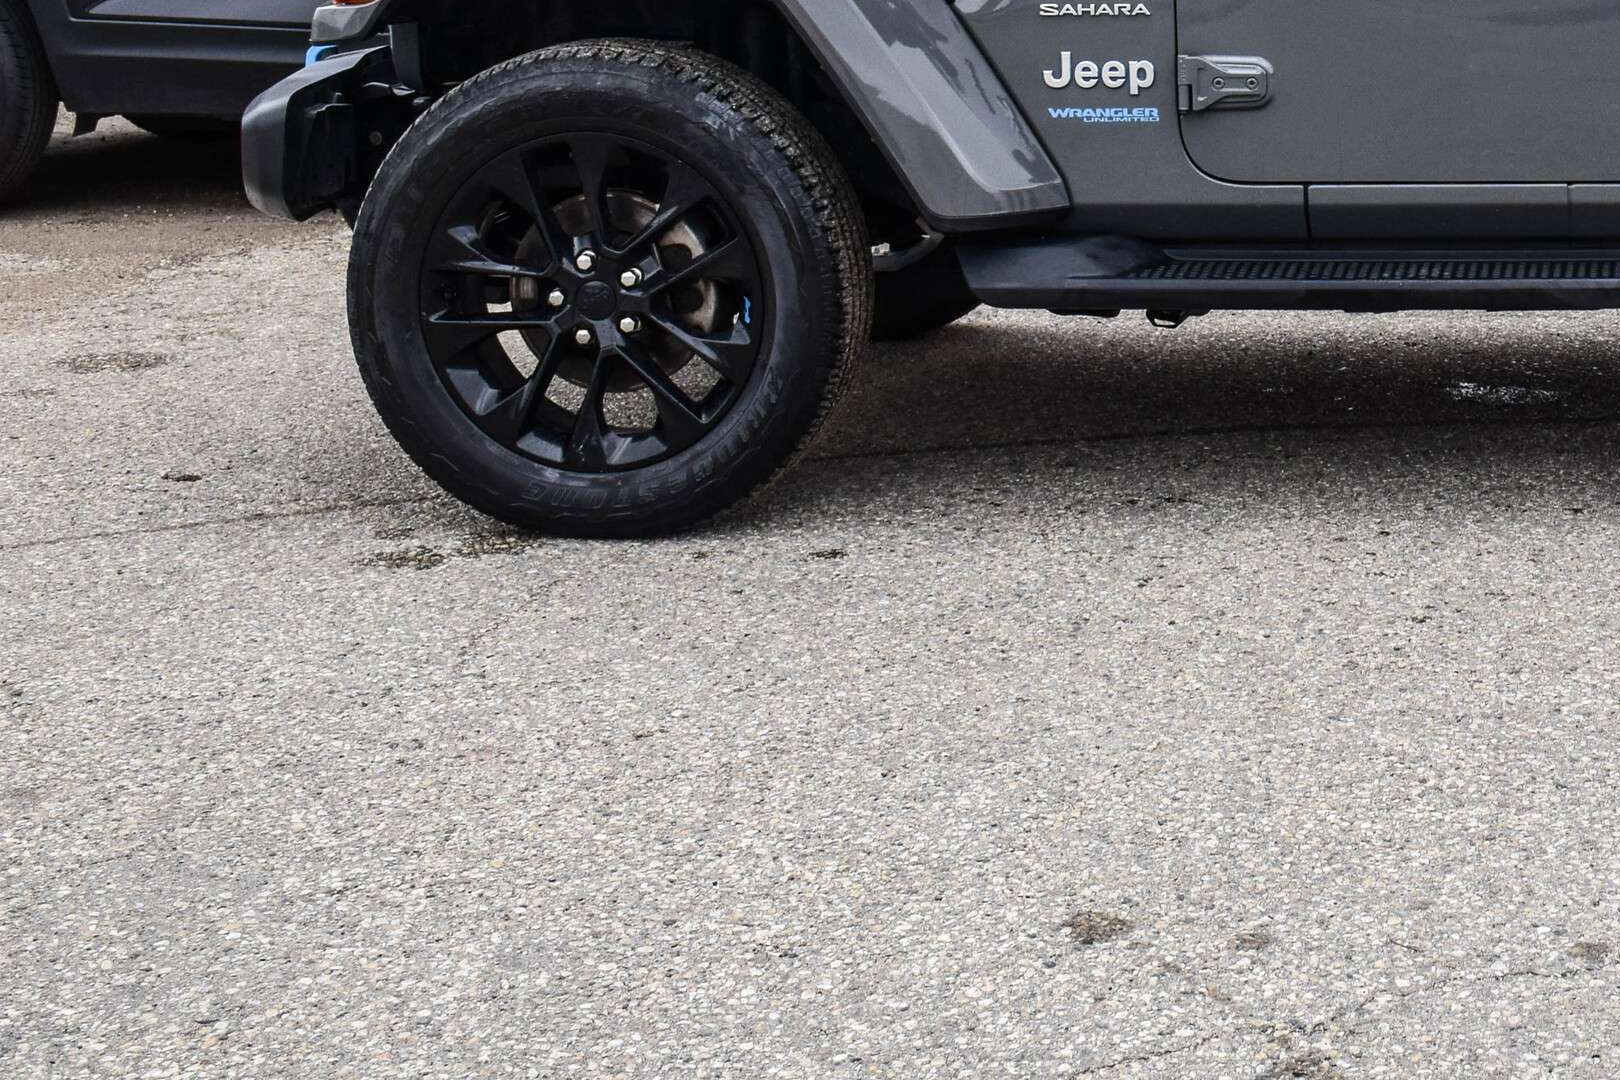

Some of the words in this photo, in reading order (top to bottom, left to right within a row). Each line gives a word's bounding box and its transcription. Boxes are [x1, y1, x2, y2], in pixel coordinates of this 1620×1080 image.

[1039, 3, 1151, 16] SAHARA
[1043, 51, 1155, 95] Jeep
[1048, 107, 1159, 118] WRANGLER
